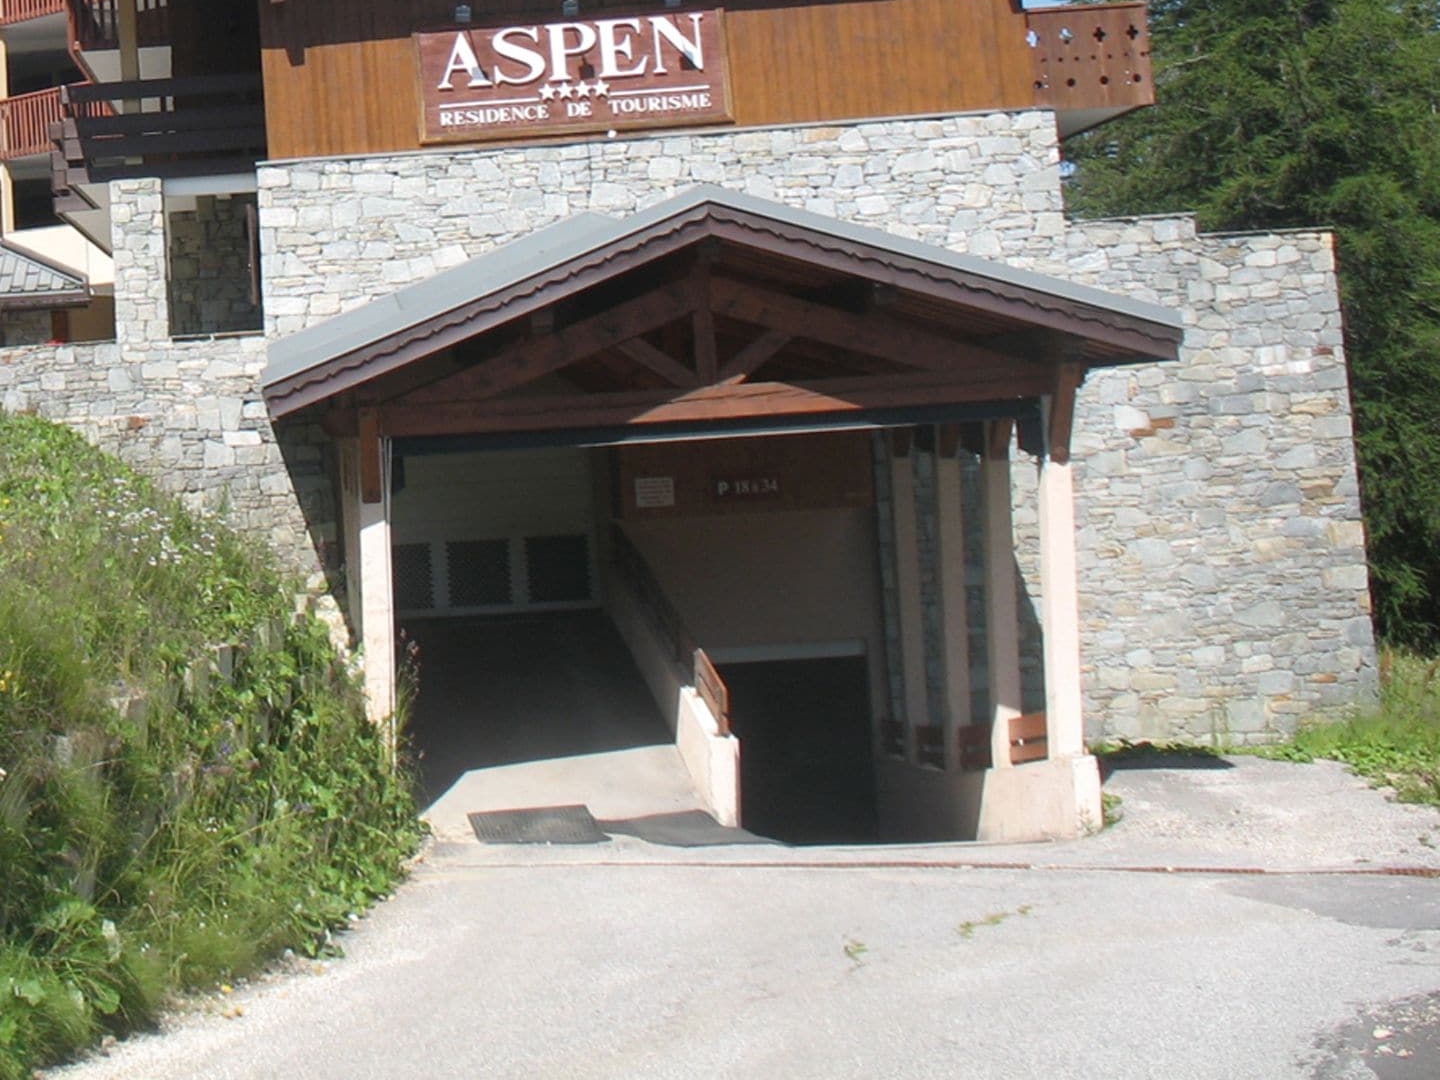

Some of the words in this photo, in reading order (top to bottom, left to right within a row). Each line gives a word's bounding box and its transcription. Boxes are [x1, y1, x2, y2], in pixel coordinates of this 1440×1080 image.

[437, 12, 704, 90] ASPEN
[439, 104, 550, 126] RESIDENCE
[567, 102, 592, 118] DE
[608, 93, 712, 115] TOURISME
[717, 480, 729, 496] P
